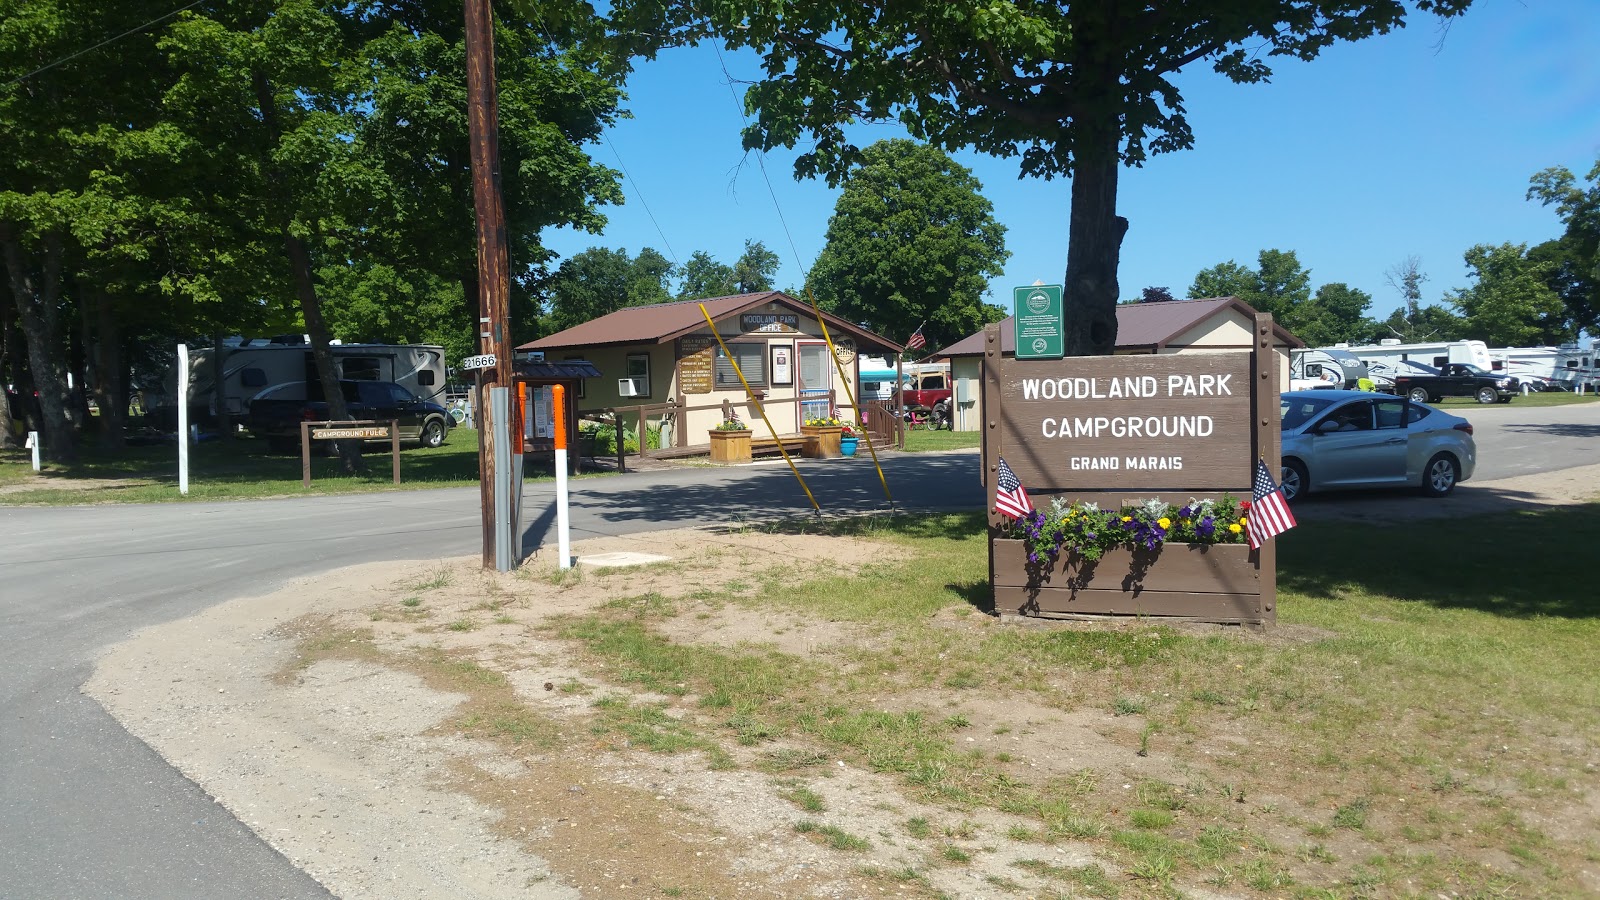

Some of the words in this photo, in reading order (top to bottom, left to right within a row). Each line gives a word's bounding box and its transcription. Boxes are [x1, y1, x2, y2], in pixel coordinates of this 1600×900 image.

[743, 315, 777, 324] WOODLAND
[779, 315, 796, 324] PARK
[759, 323, 782, 332] OFFICE
[836, 347, 853, 356] OFFICE
[1022, 376, 1158, 400] WOODLAND
[1168, 374, 1232, 397] PARK
[1042, 415, 1214, 438] CAMPGROUND
[317, 429, 364, 438] CAMPGROUND
[365, 429, 383, 437] FULL
[1071, 457, 1120, 470] GRAND
[1126, 456, 1183, 470] MARAIS
